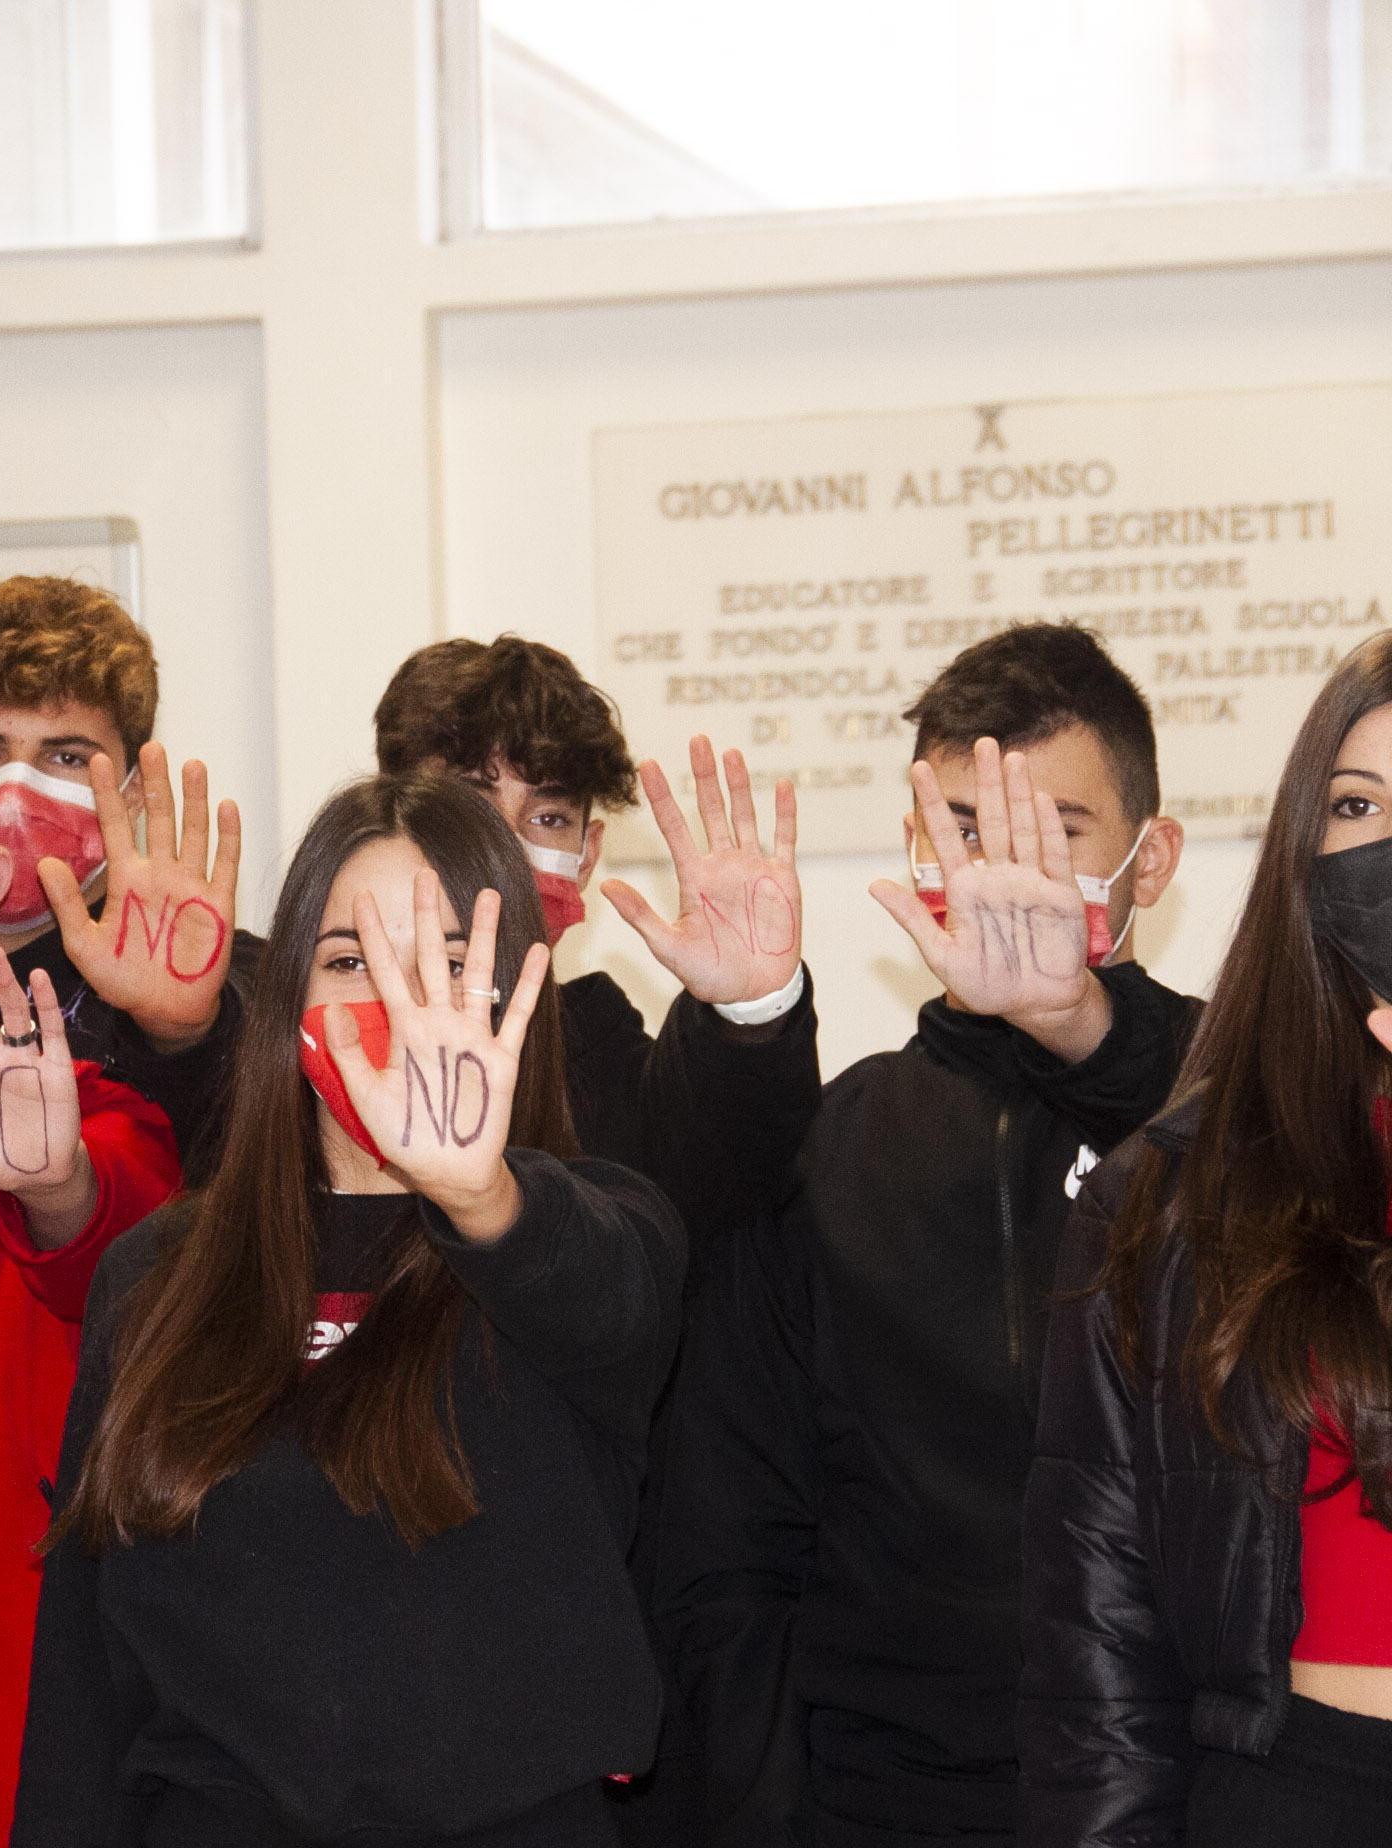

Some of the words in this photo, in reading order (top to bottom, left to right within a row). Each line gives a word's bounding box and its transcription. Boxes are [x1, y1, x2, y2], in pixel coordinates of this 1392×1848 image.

[658, 471, 867, 521] GIOVANNI
[894, 458, 1118, 509] ALFONSO
[965, 499, 1337, 559] PELLEGRINETTI
[718, 574, 927, 615] EDUCATORE
[971, 569, 996, 603] E
[1041, 556, 1248, 600] SCRITTORE
[1237, 596, 1386, 632] SCUOLA
[664, 666, 900, 705] RENDENDOLA
[113, 888, 226, 984] NO
[698, 874, 796, 967] NO
[401, 1045, 490, 1148] NO
